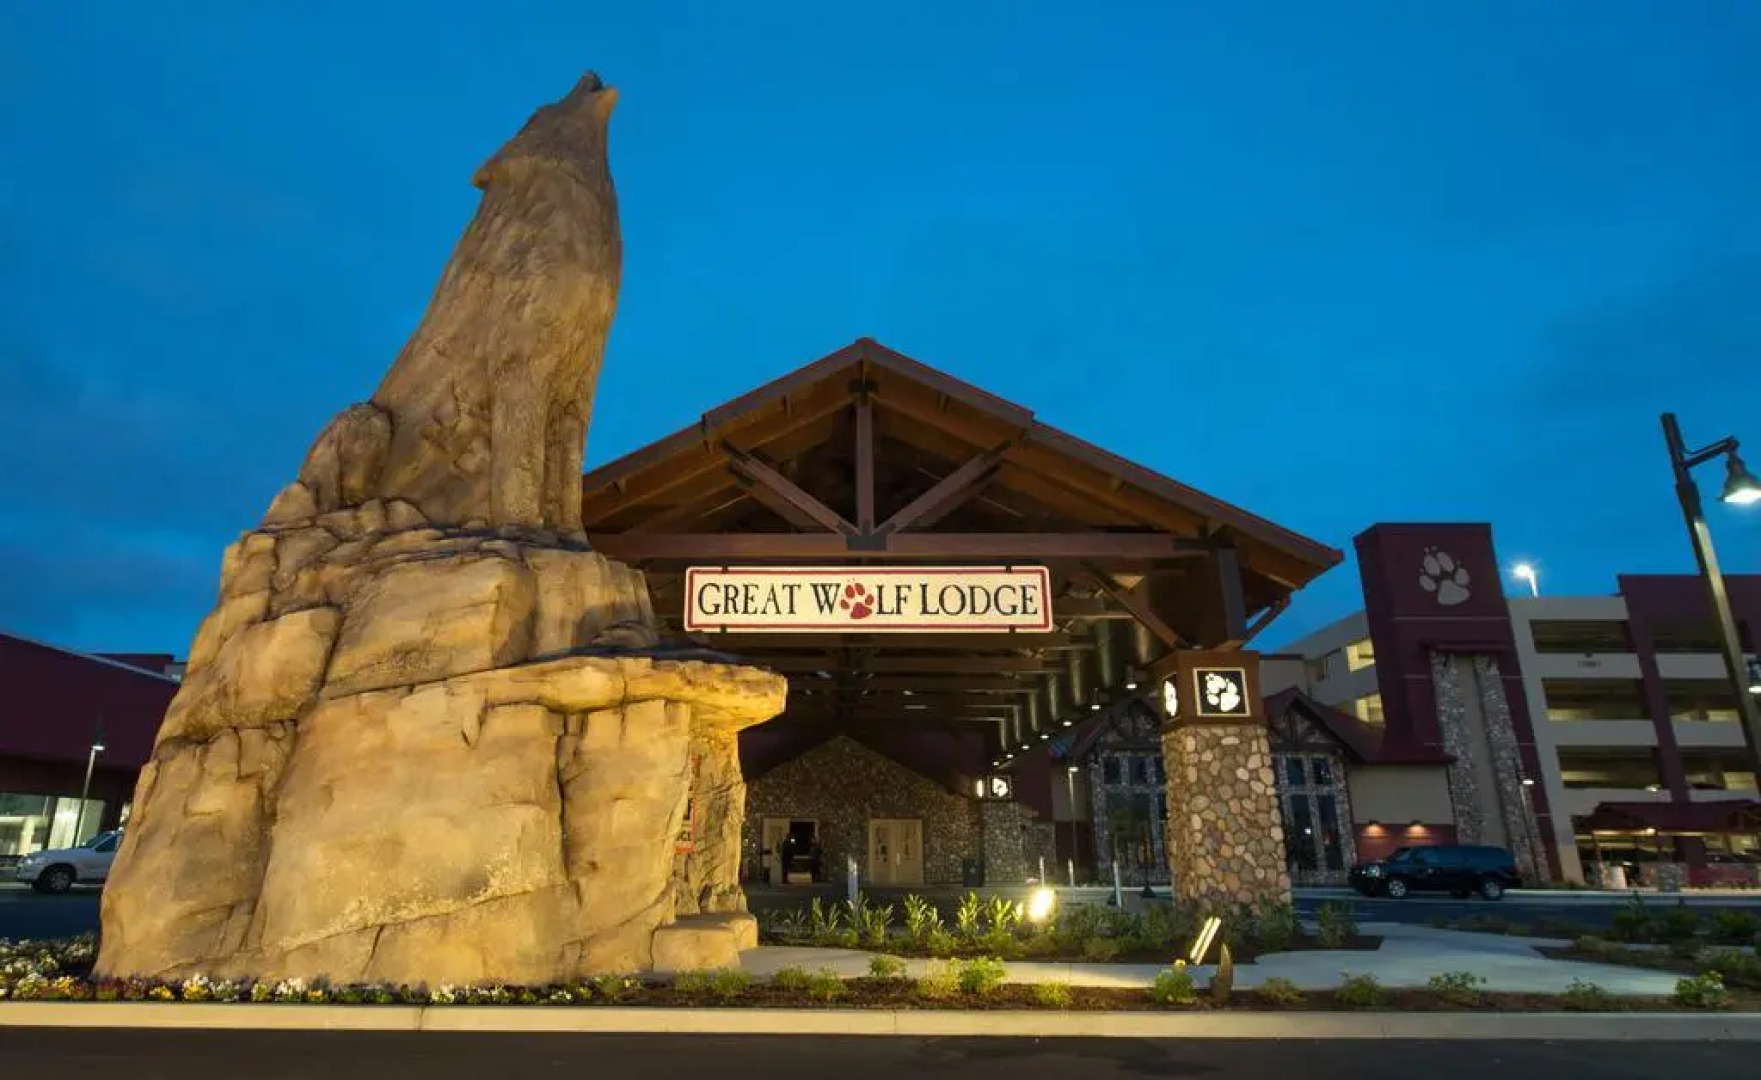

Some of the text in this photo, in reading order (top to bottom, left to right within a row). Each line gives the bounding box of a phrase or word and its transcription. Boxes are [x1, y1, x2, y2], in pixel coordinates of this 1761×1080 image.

[698, 580, 1038, 618] GREAT WLF LODGE
